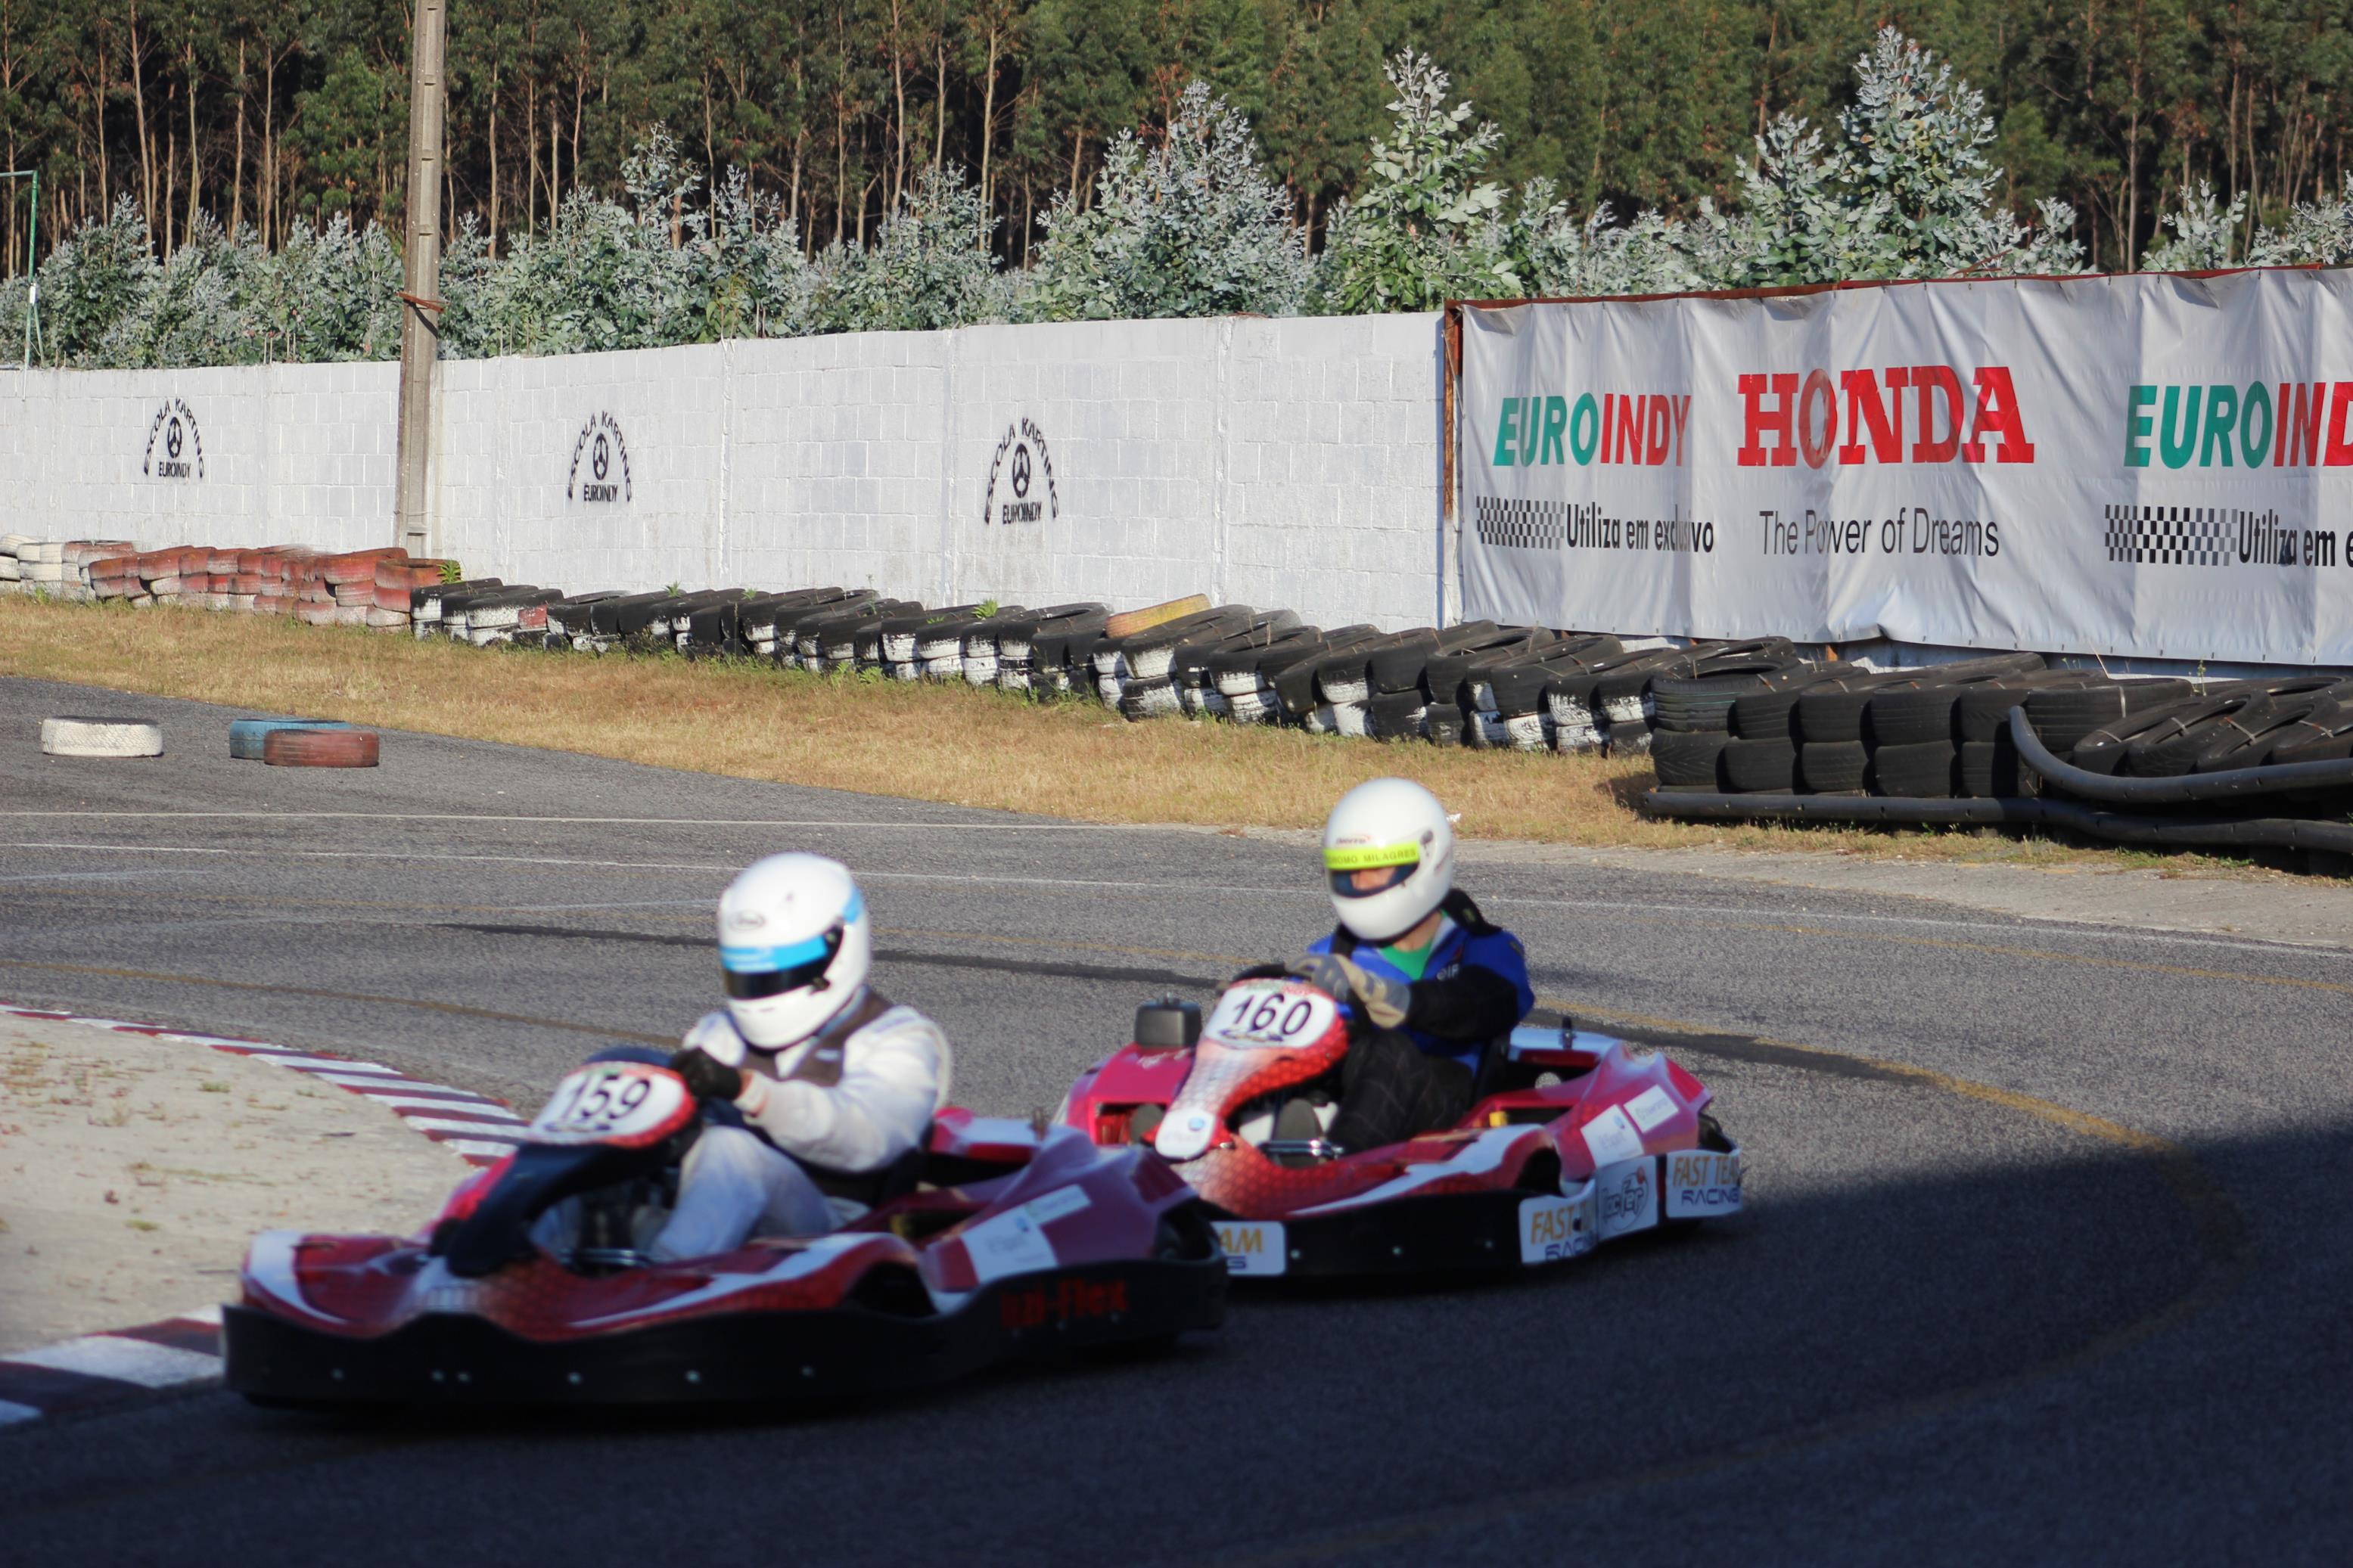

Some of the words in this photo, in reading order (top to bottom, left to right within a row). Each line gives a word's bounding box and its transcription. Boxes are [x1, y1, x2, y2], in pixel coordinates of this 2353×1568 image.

[144, 399, 171, 477] ESCOLA
[175, 396, 204, 479] KARTING
[1492, 392, 1692, 467] EUROINDY
[1737, 365, 2034, 470] HONDA
[2124, 380, 2353, 469] EUROIND
[158, 461, 191, 478] EUROINDY
[567, 413, 596, 500] ESCOLA
[601, 410, 633, 502] KARTING
[984, 423, 1016, 525] ESCOLA
[1022, 417, 1059, 520] KARTING
[583, 484, 618, 502] EUROINDY
[1002, 501, 1042, 525] EUROINDY
[1567, 501, 1621, 548] Utiliza
[1626, 519, 1649, 550] em
[1759, 510, 1798, 556] The
[1804, 509, 1871, 556] Power
[1882, 507, 1906, 554] of
[1913, 508, 1999, 557] Dreams
[2238, 508, 2298, 566] Utiliza
[2303, 529, 2336, 567] em
[1233, 992, 1312, 1036] 160
[561, 1073, 651, 1120] 159
[1673, 1156, 1710, 1187] FAST
[1681, 1187, 1739, 1206] RACING
[1531, 1204, 1574, 1246] FAST
